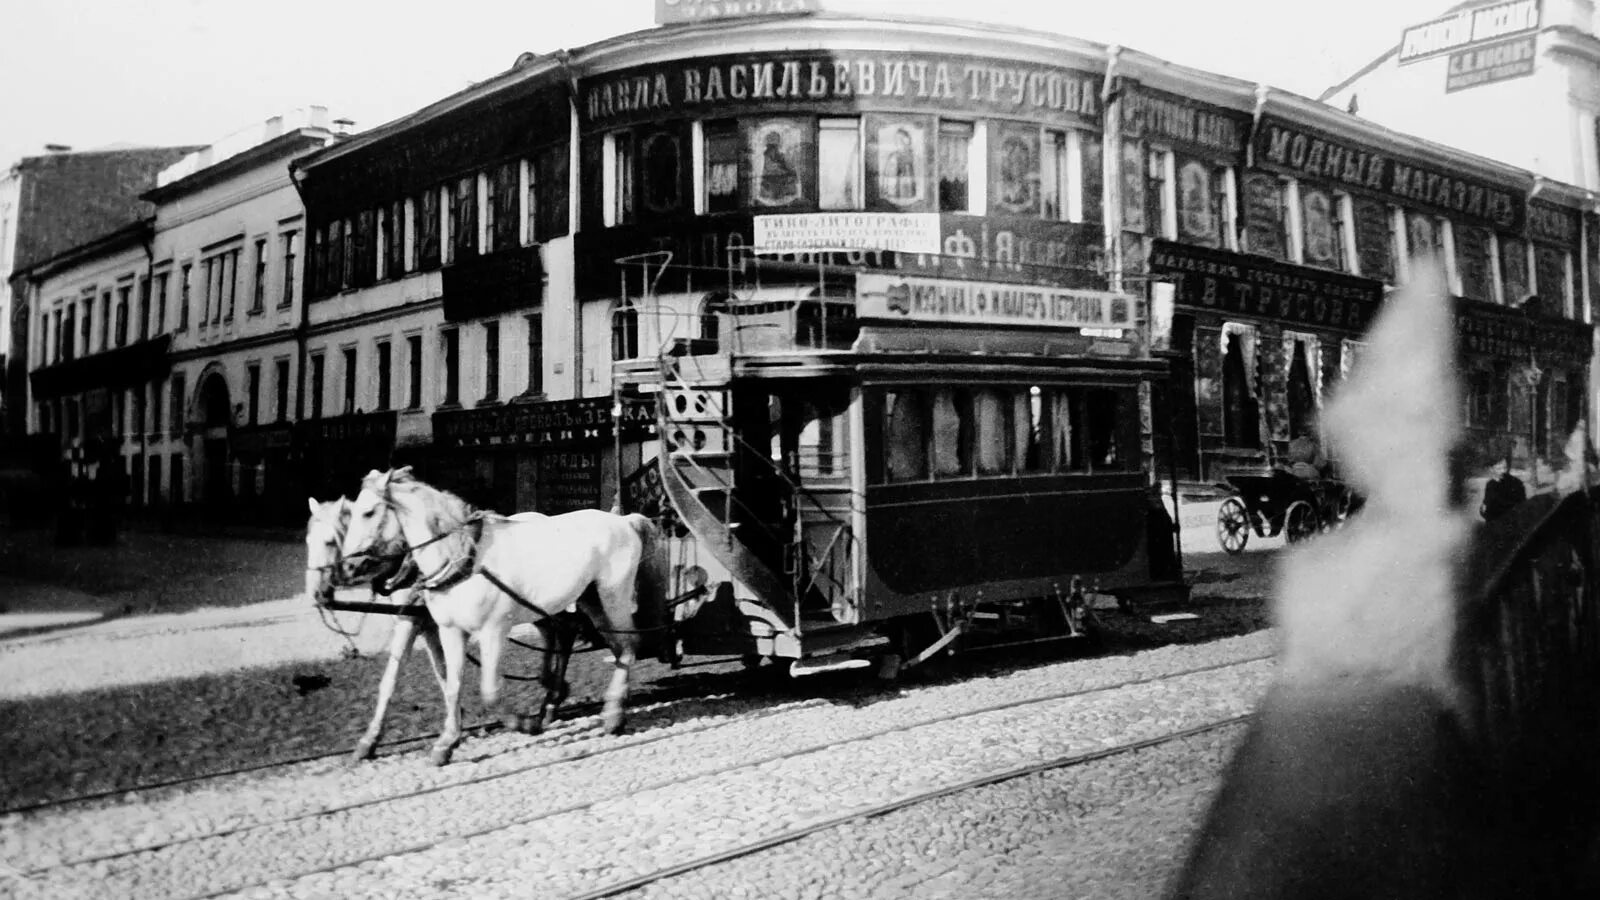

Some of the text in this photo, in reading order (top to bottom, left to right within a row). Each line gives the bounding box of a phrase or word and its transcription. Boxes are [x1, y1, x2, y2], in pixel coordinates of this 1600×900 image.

[684, 60, 953, 103] ВАСИЛЬЕВИЧА
[964, 64, 1098, 115] ТРУСОВА
[1266, 126, 1385, 190] МОДНЫЙ
[1391, 165, 1515, 227] МАГАЗИНЪ
[1234, 281, 1361, 327] ТРУСОВА
[584, 405, 661, 425] ЗЕКА
